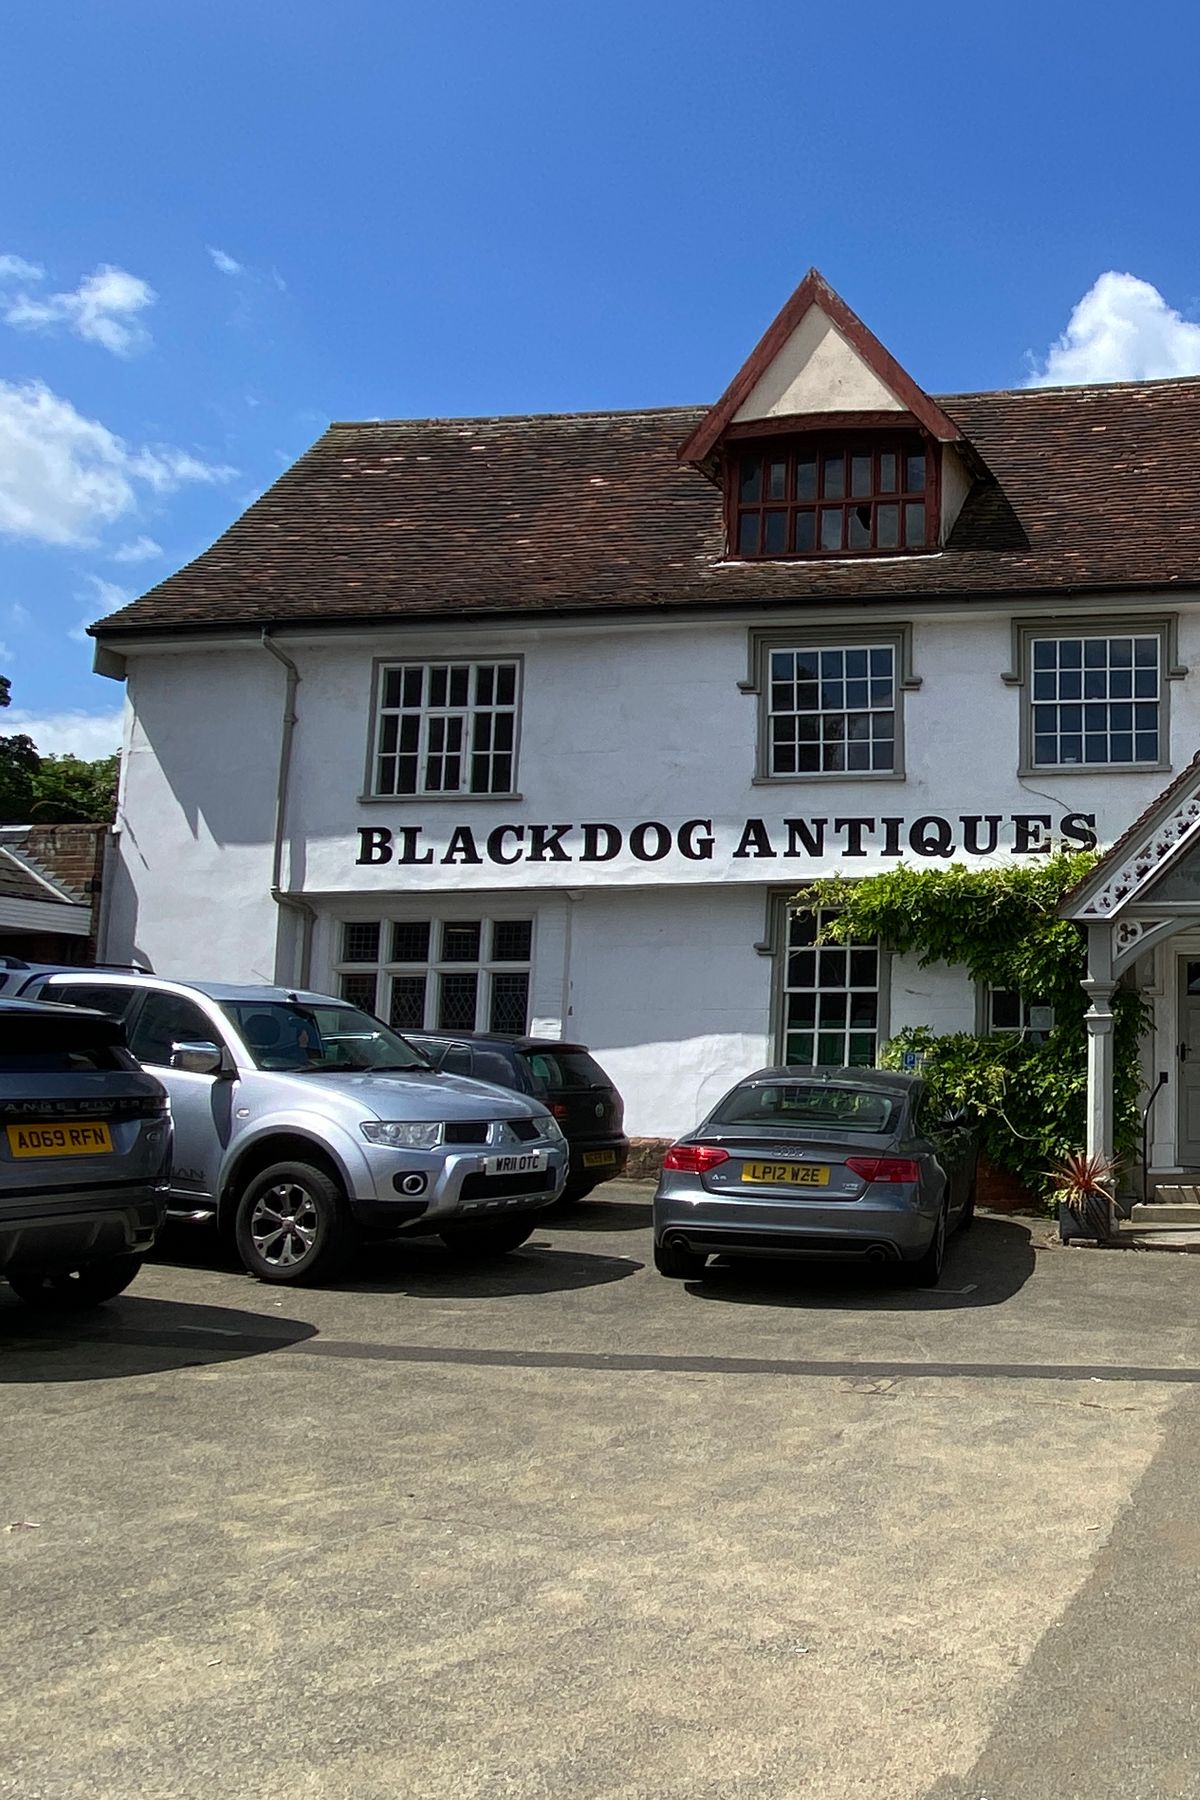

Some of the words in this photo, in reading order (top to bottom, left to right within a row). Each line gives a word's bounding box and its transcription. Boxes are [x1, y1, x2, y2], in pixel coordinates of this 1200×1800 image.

[355, 819, 716, 866] BLACKDOG
[732, 813, 1098, 859] ANTIQUES
[4, 1100, 67, 1113] ANGE
[18, 1129, 66, 1149] AO69
[69, 1127, 106, 1146] RFN
[520, 1155, 539, 1170] OTC
[751, 1164, 787, 1181] LP12
[790, 1167, 821, 1183] WZE
